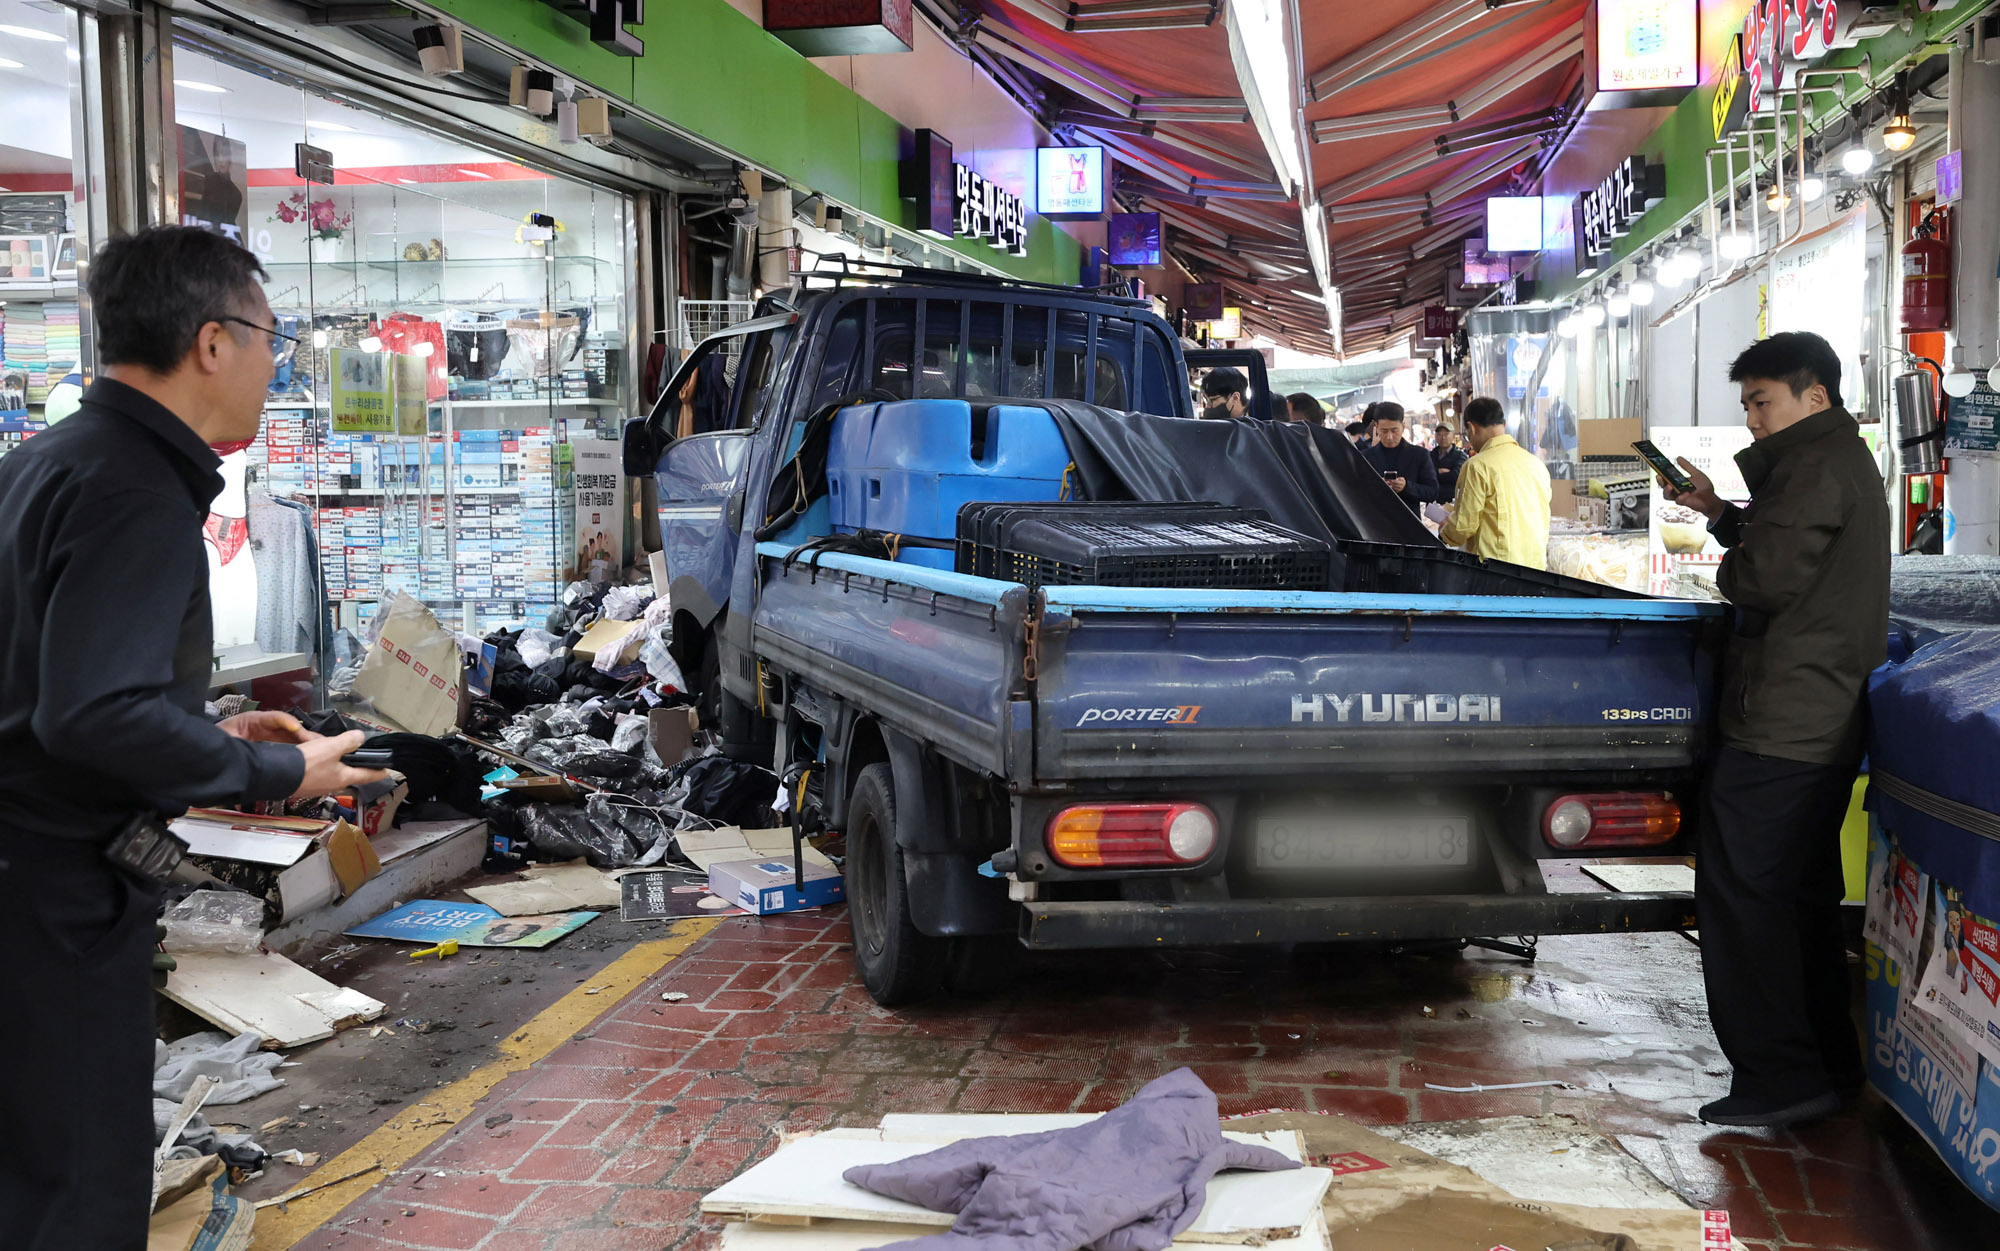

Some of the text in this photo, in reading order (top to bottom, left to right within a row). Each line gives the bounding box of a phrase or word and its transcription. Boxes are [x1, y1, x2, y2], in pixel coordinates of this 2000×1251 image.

[956, 163, 1028, 258] 명동패션타운
[1583, 156, 1635, 257] 원종제일가구
[1291, 693, 1501, 722] HYUNDAI
[1650, 708, 1692, 720] CRDi
[393, 915, 473, 928] BODY
[431, 909, 487, 920] DRY
